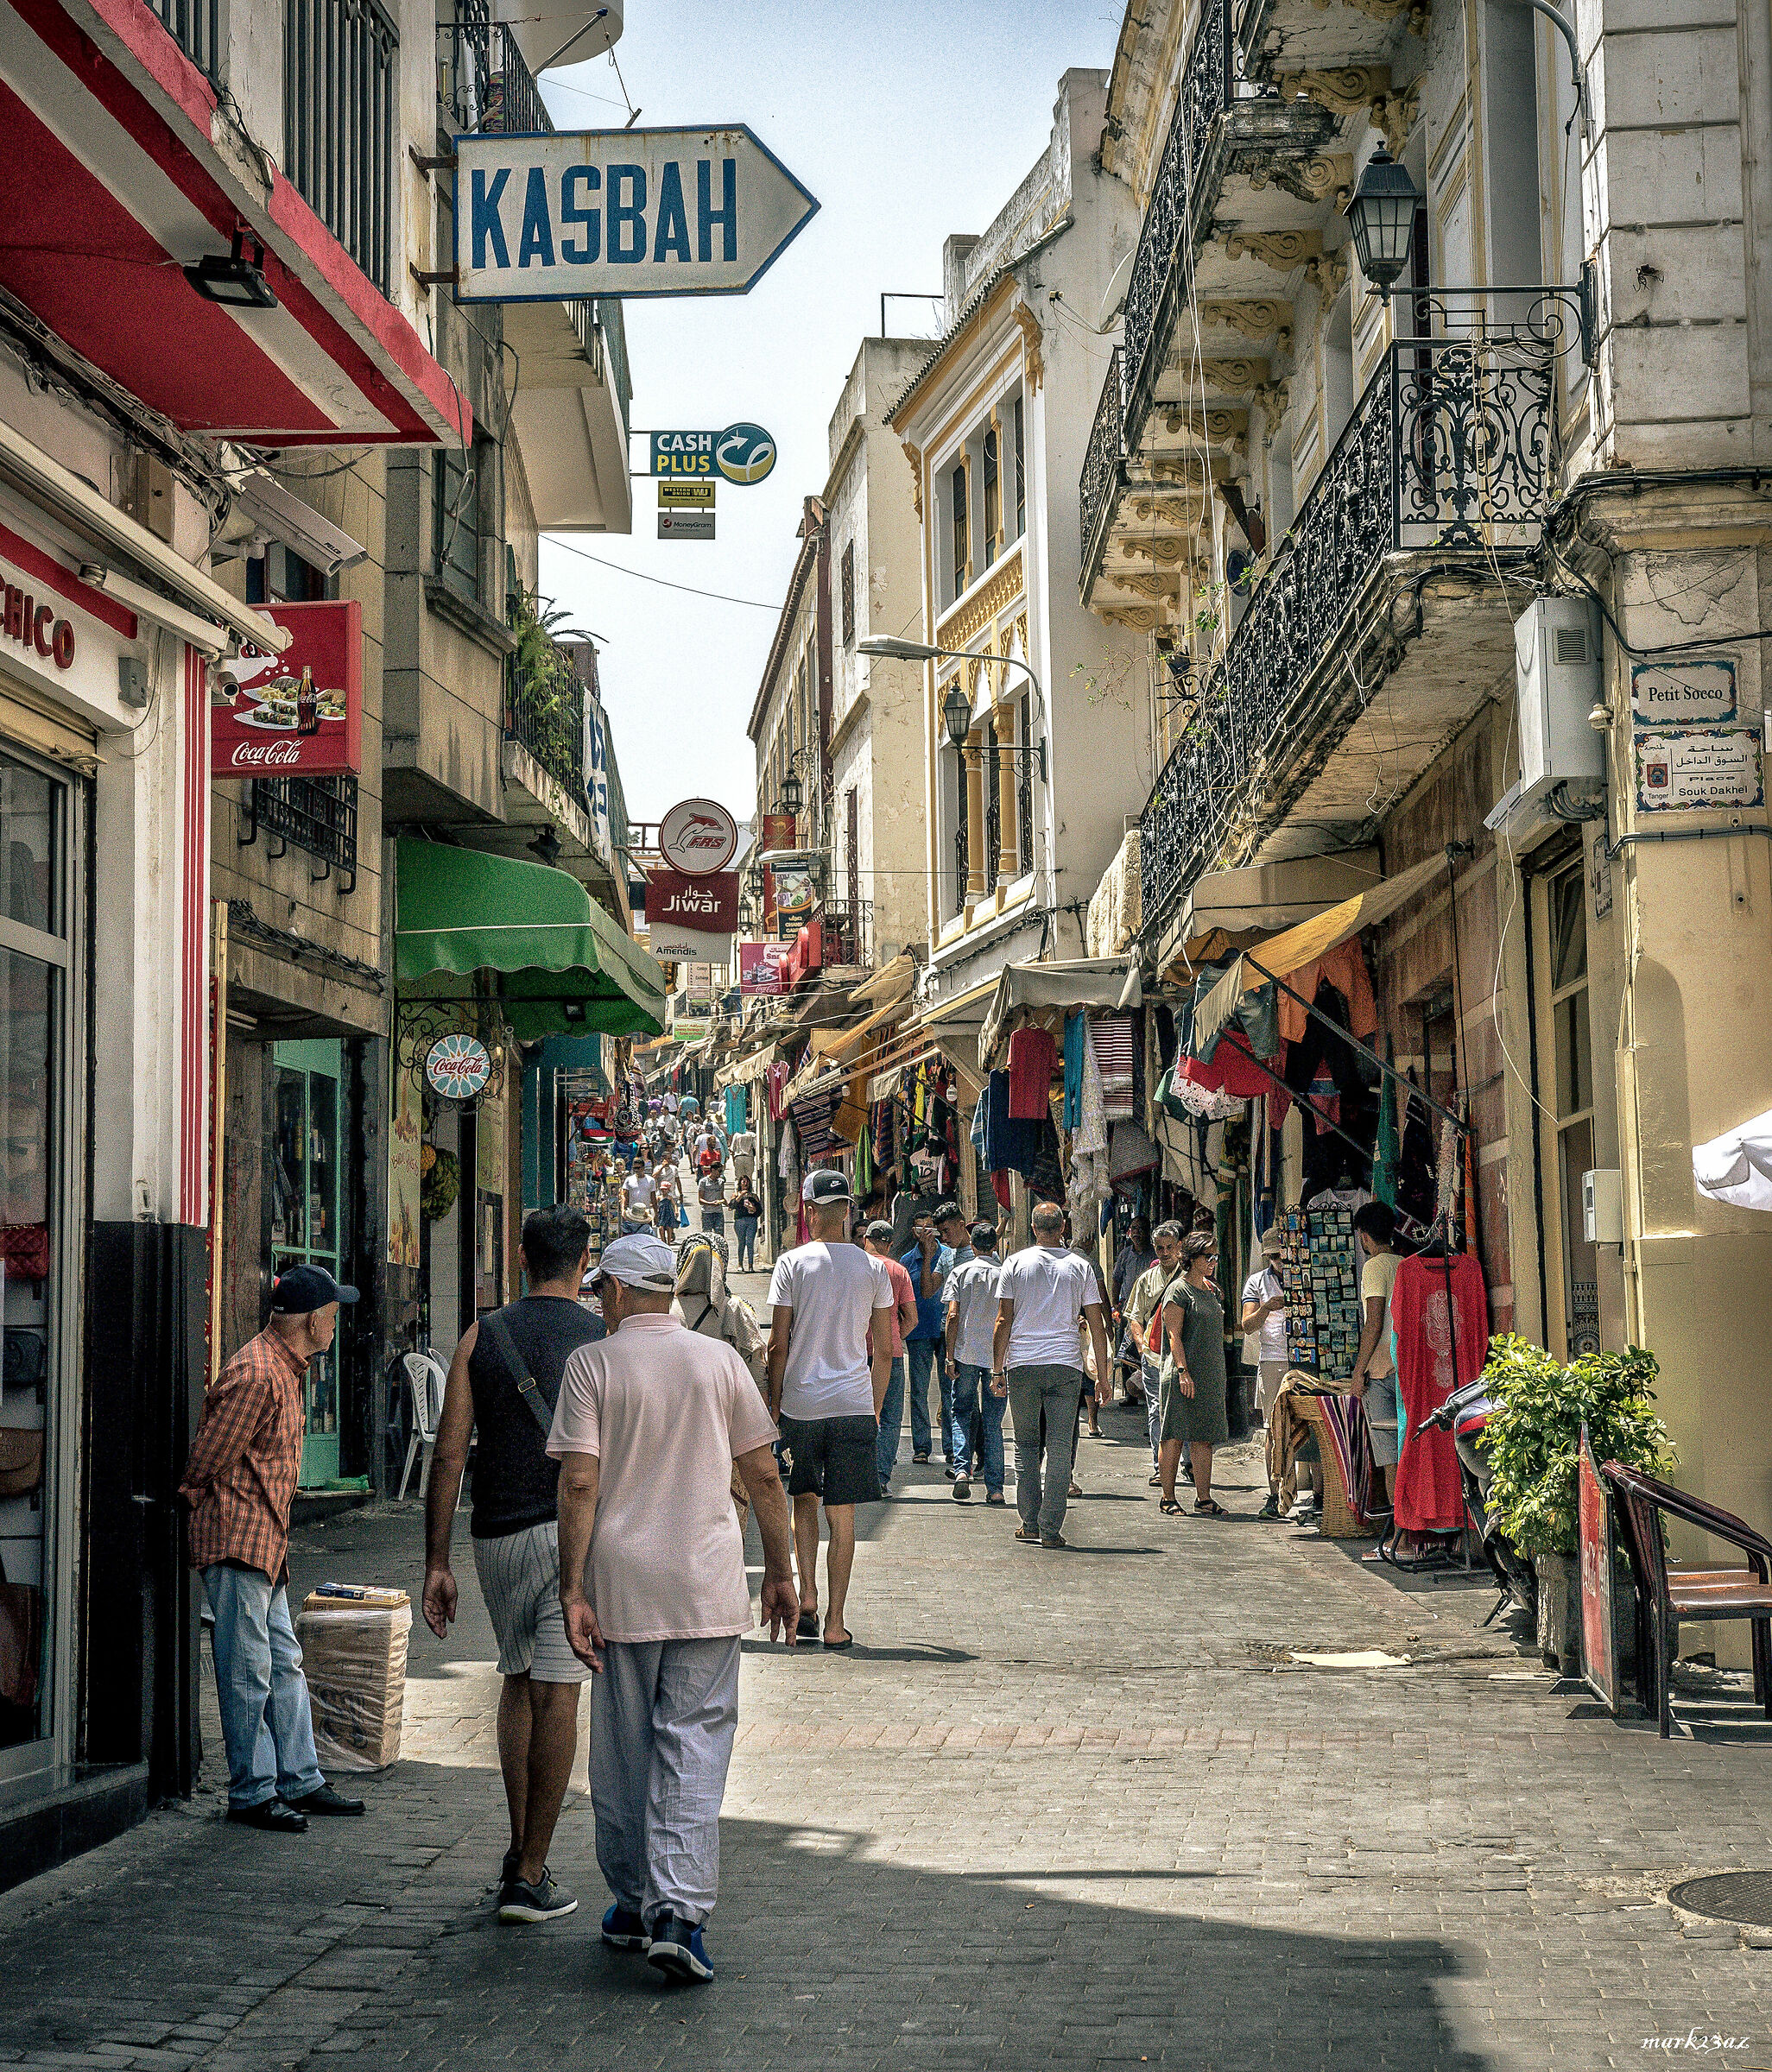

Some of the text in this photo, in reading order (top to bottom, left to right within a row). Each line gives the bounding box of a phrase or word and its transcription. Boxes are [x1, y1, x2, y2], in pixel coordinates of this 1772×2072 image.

[471, 159, 737, 268] KASBAH
[657, 434, 712, 452] CASH
[657, 455, 710, 472] PLUS
[1648, 685, 1723, 701] Petit Socco
[231, 739, 305, 766] Coca-Cola
[1687, 744, 1734, 753] ساحة
[1675, 754, 1748, 768] السوق الداخل
[1648, 792, 1669, 800] Tanger
[1679, 786, 1748, 797] Souk Dakhel
[688, 837, 725, 848] FRS
[682, 885, 713, 900] جوار
[662, 894, 722, 913] Jiwar
[656, 947, 697, 956] Amendis
[434, 1056, 485, 1075] Coca-Cola
